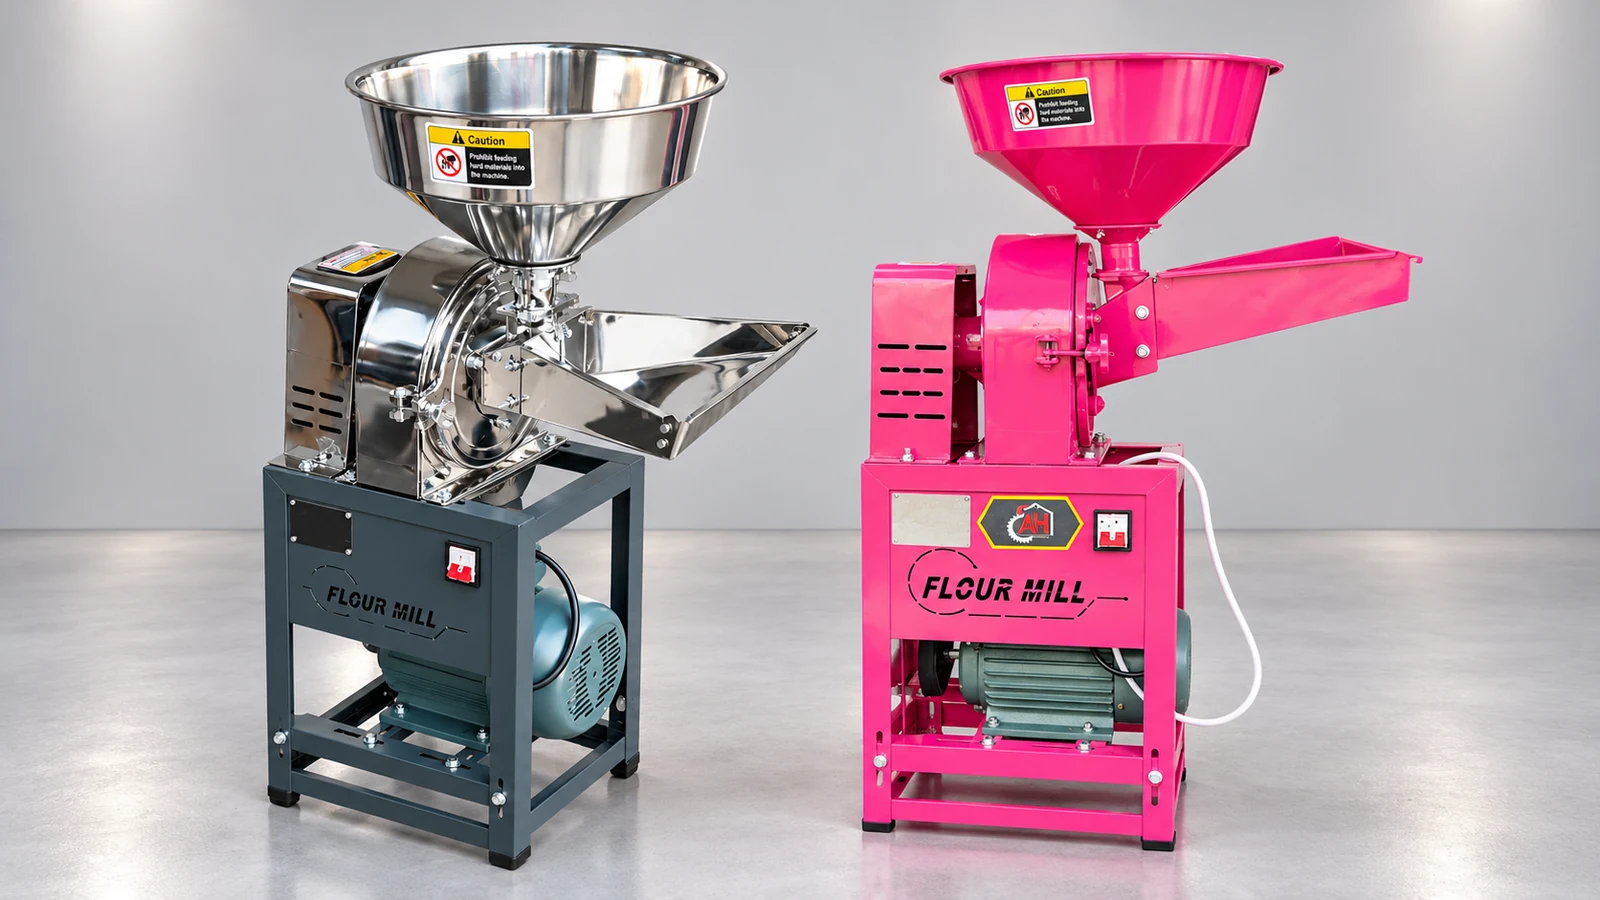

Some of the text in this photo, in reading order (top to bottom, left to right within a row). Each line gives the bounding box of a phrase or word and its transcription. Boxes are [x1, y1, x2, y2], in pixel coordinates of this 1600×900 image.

[1036, 87, 1065, 96] Caution
[468, 135, 505, 145] Caution
[1018, 511, 1050, 535] AH
[922, 576, 1086, 604] FLOUR MILL
[326, 585, 436, 629] FLOUR MILL
